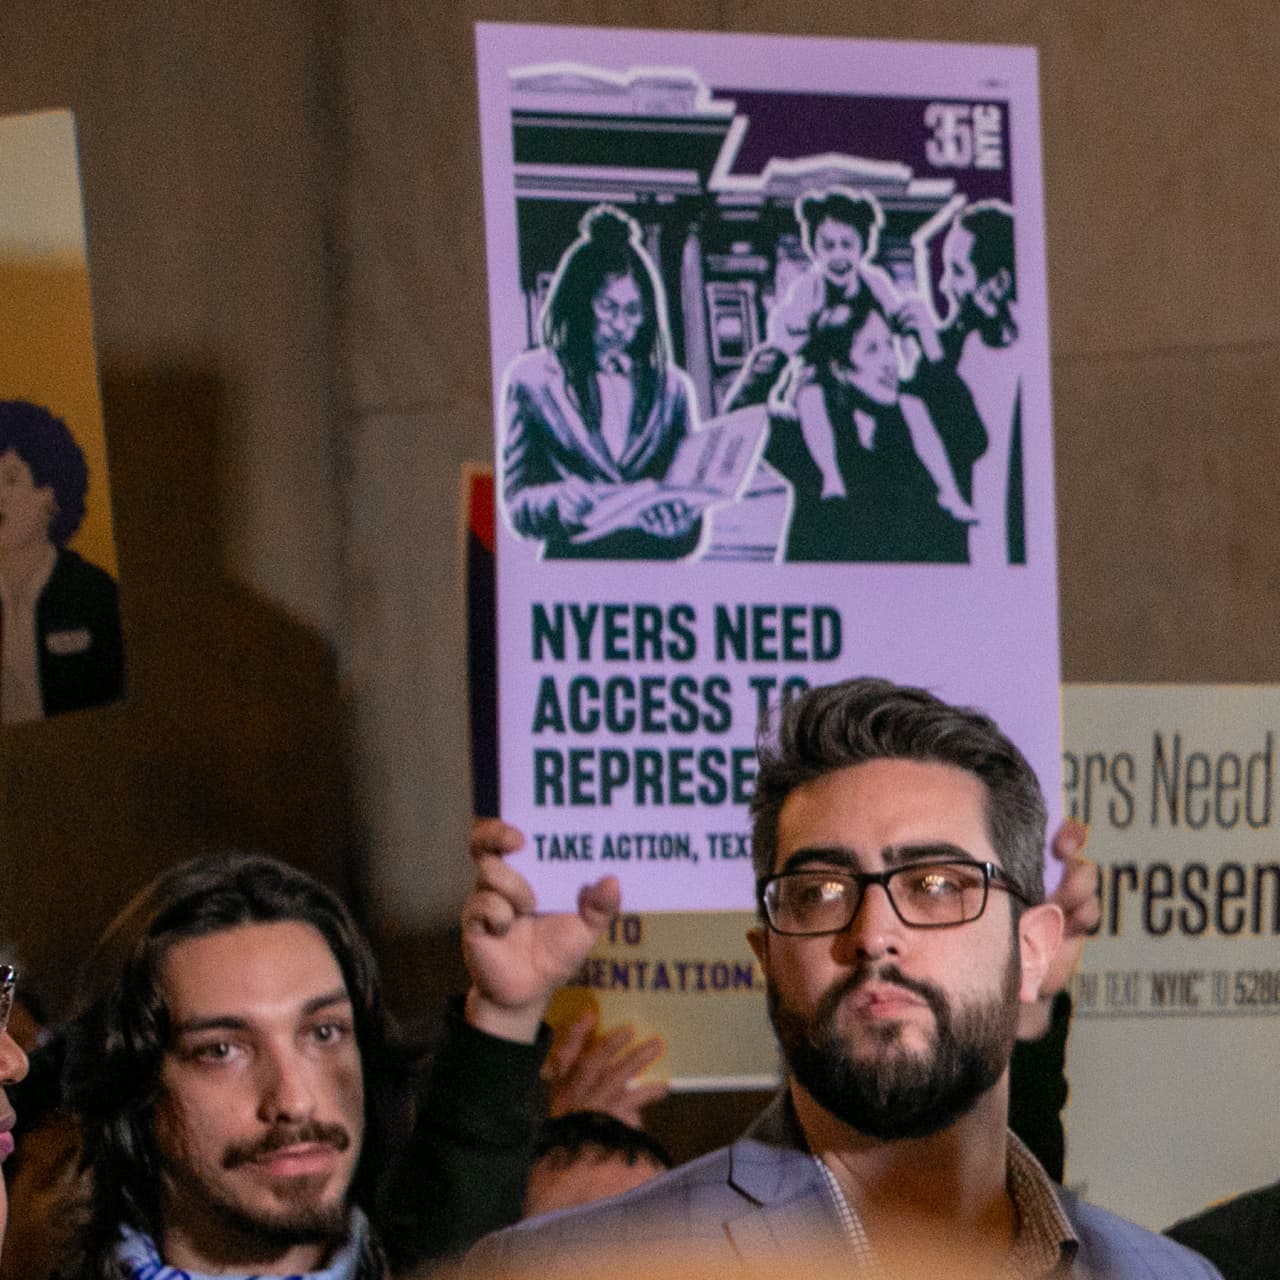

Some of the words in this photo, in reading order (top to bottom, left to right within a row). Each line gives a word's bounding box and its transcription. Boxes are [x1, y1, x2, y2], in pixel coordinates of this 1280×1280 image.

[531, 602, 699, 662] NYERS
[712, 604, 843, 663] NEED
[530, 675, 734, 736] ACCESS
[1150, 730, 1274, 831] Need
[532, 834, 594, 862] TAKE
[599, 834, 700, 865] ACTION,
